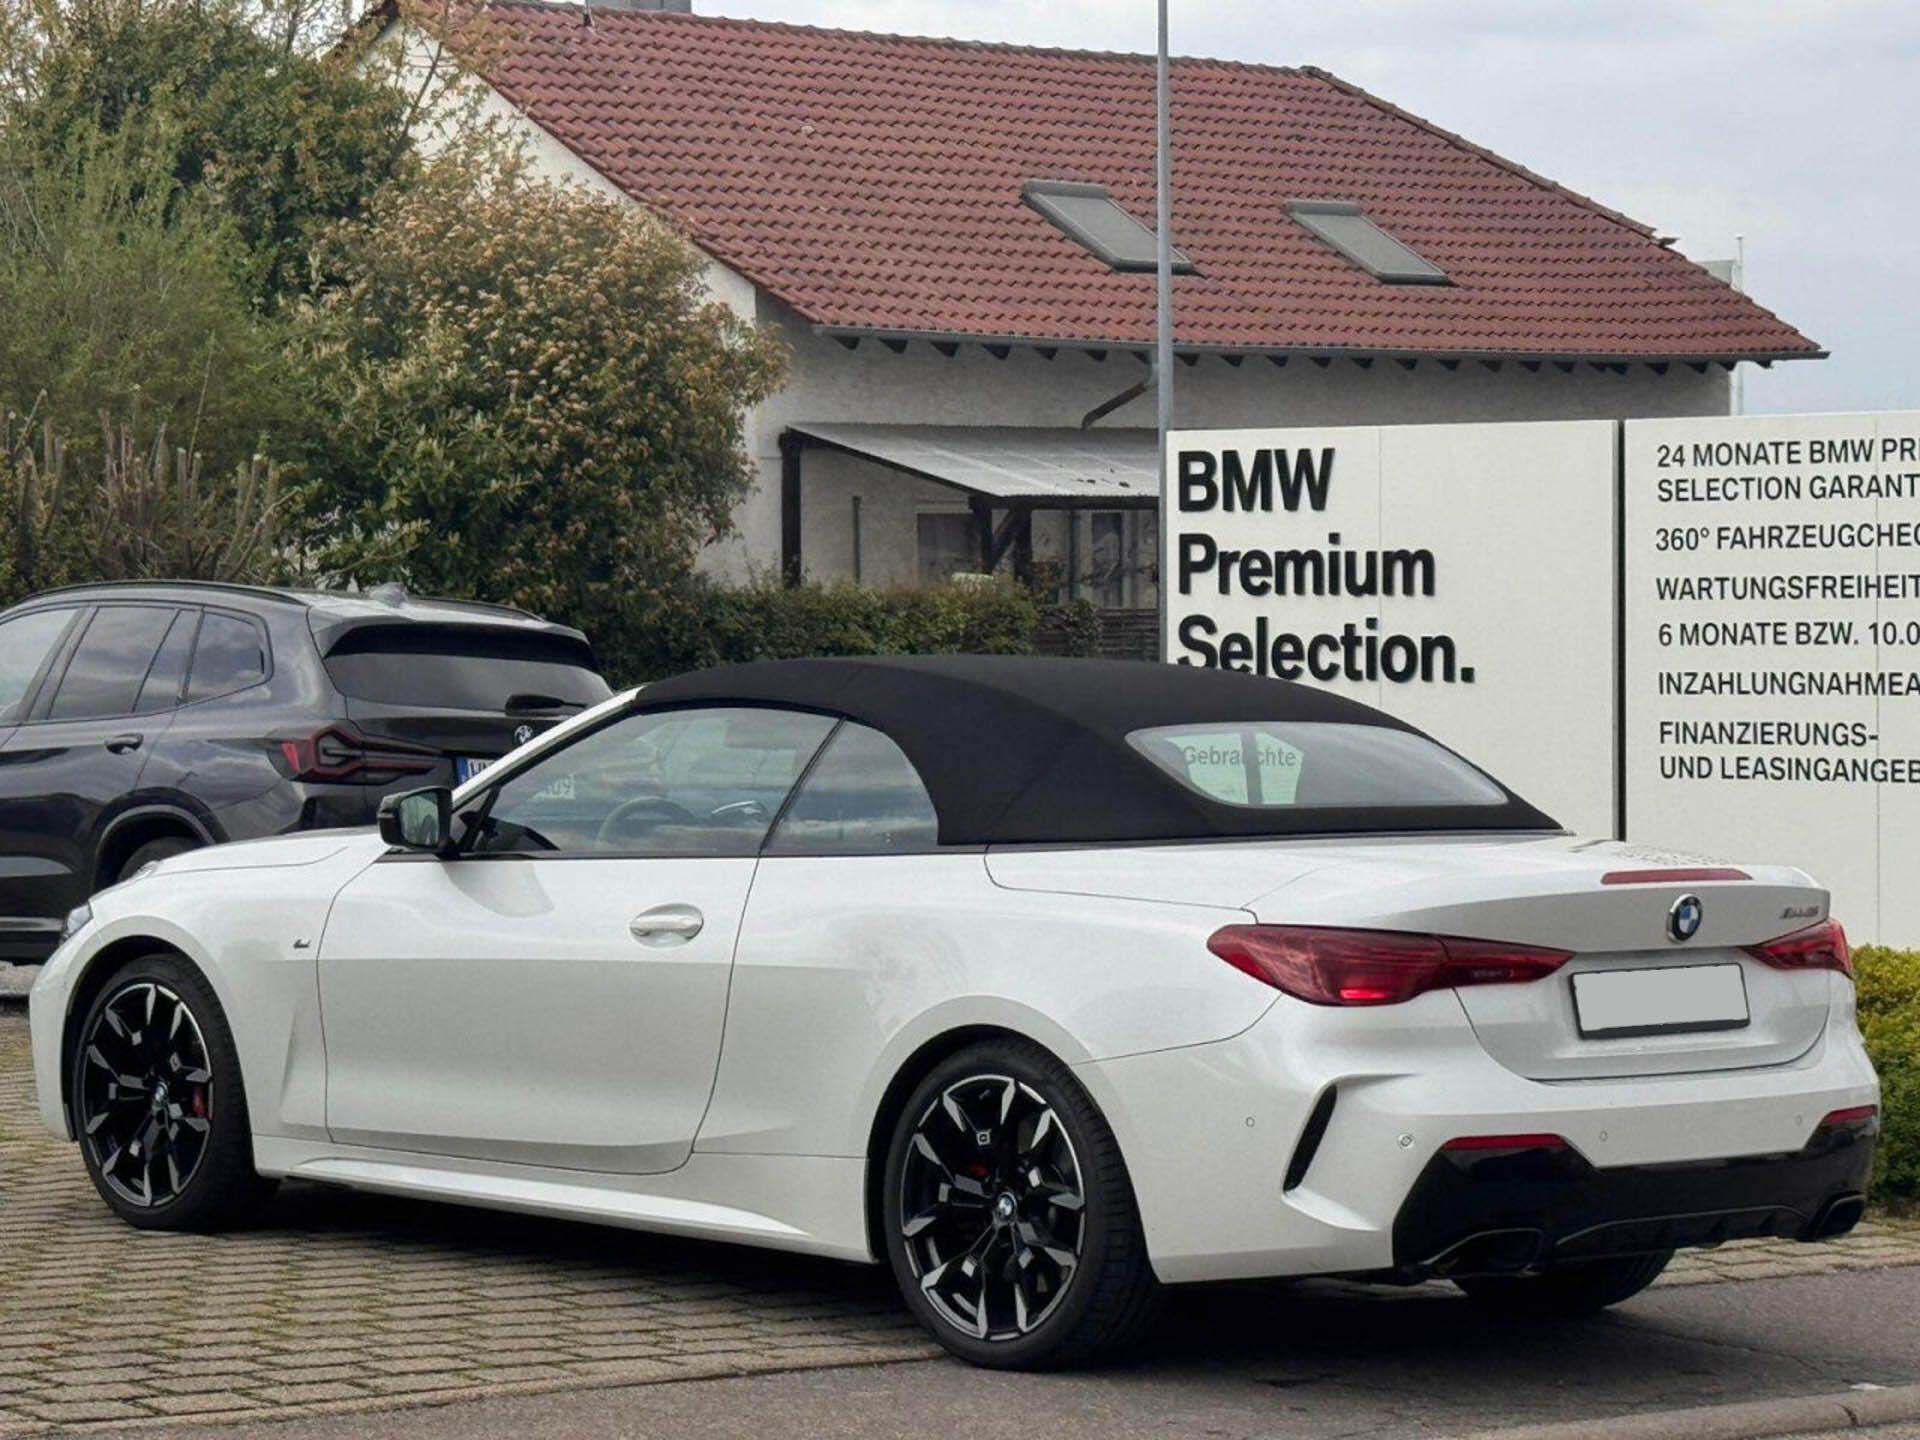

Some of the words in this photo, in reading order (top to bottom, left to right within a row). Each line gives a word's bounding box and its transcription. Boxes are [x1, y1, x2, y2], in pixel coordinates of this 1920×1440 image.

[1657, 444, 1686, 468] 24
[1693, 440, 1802, 467] MONATE
[1809, 438, 1874, 464] BMW
[1881, 437, 1920, 462] PR
[1178, 447, 1336, 513] BMW
[1657, 476, 1801, 503] SELECTION
[1178, 532, 1436, 598] Premium
[1655, 574, 1920, 601] WARTUNGSFREIHEIT
[1658, 623, 1673, 647] 6
[1679, 622, 1788, 646] MONATE
[1795, 621, 1859, 646] BZW.
[1177, 614, 1475, 684] Selection.
[1659, 721, 1879, 747] FINANZIERUNGS-
[1660, 756, 1713, 779] UND
